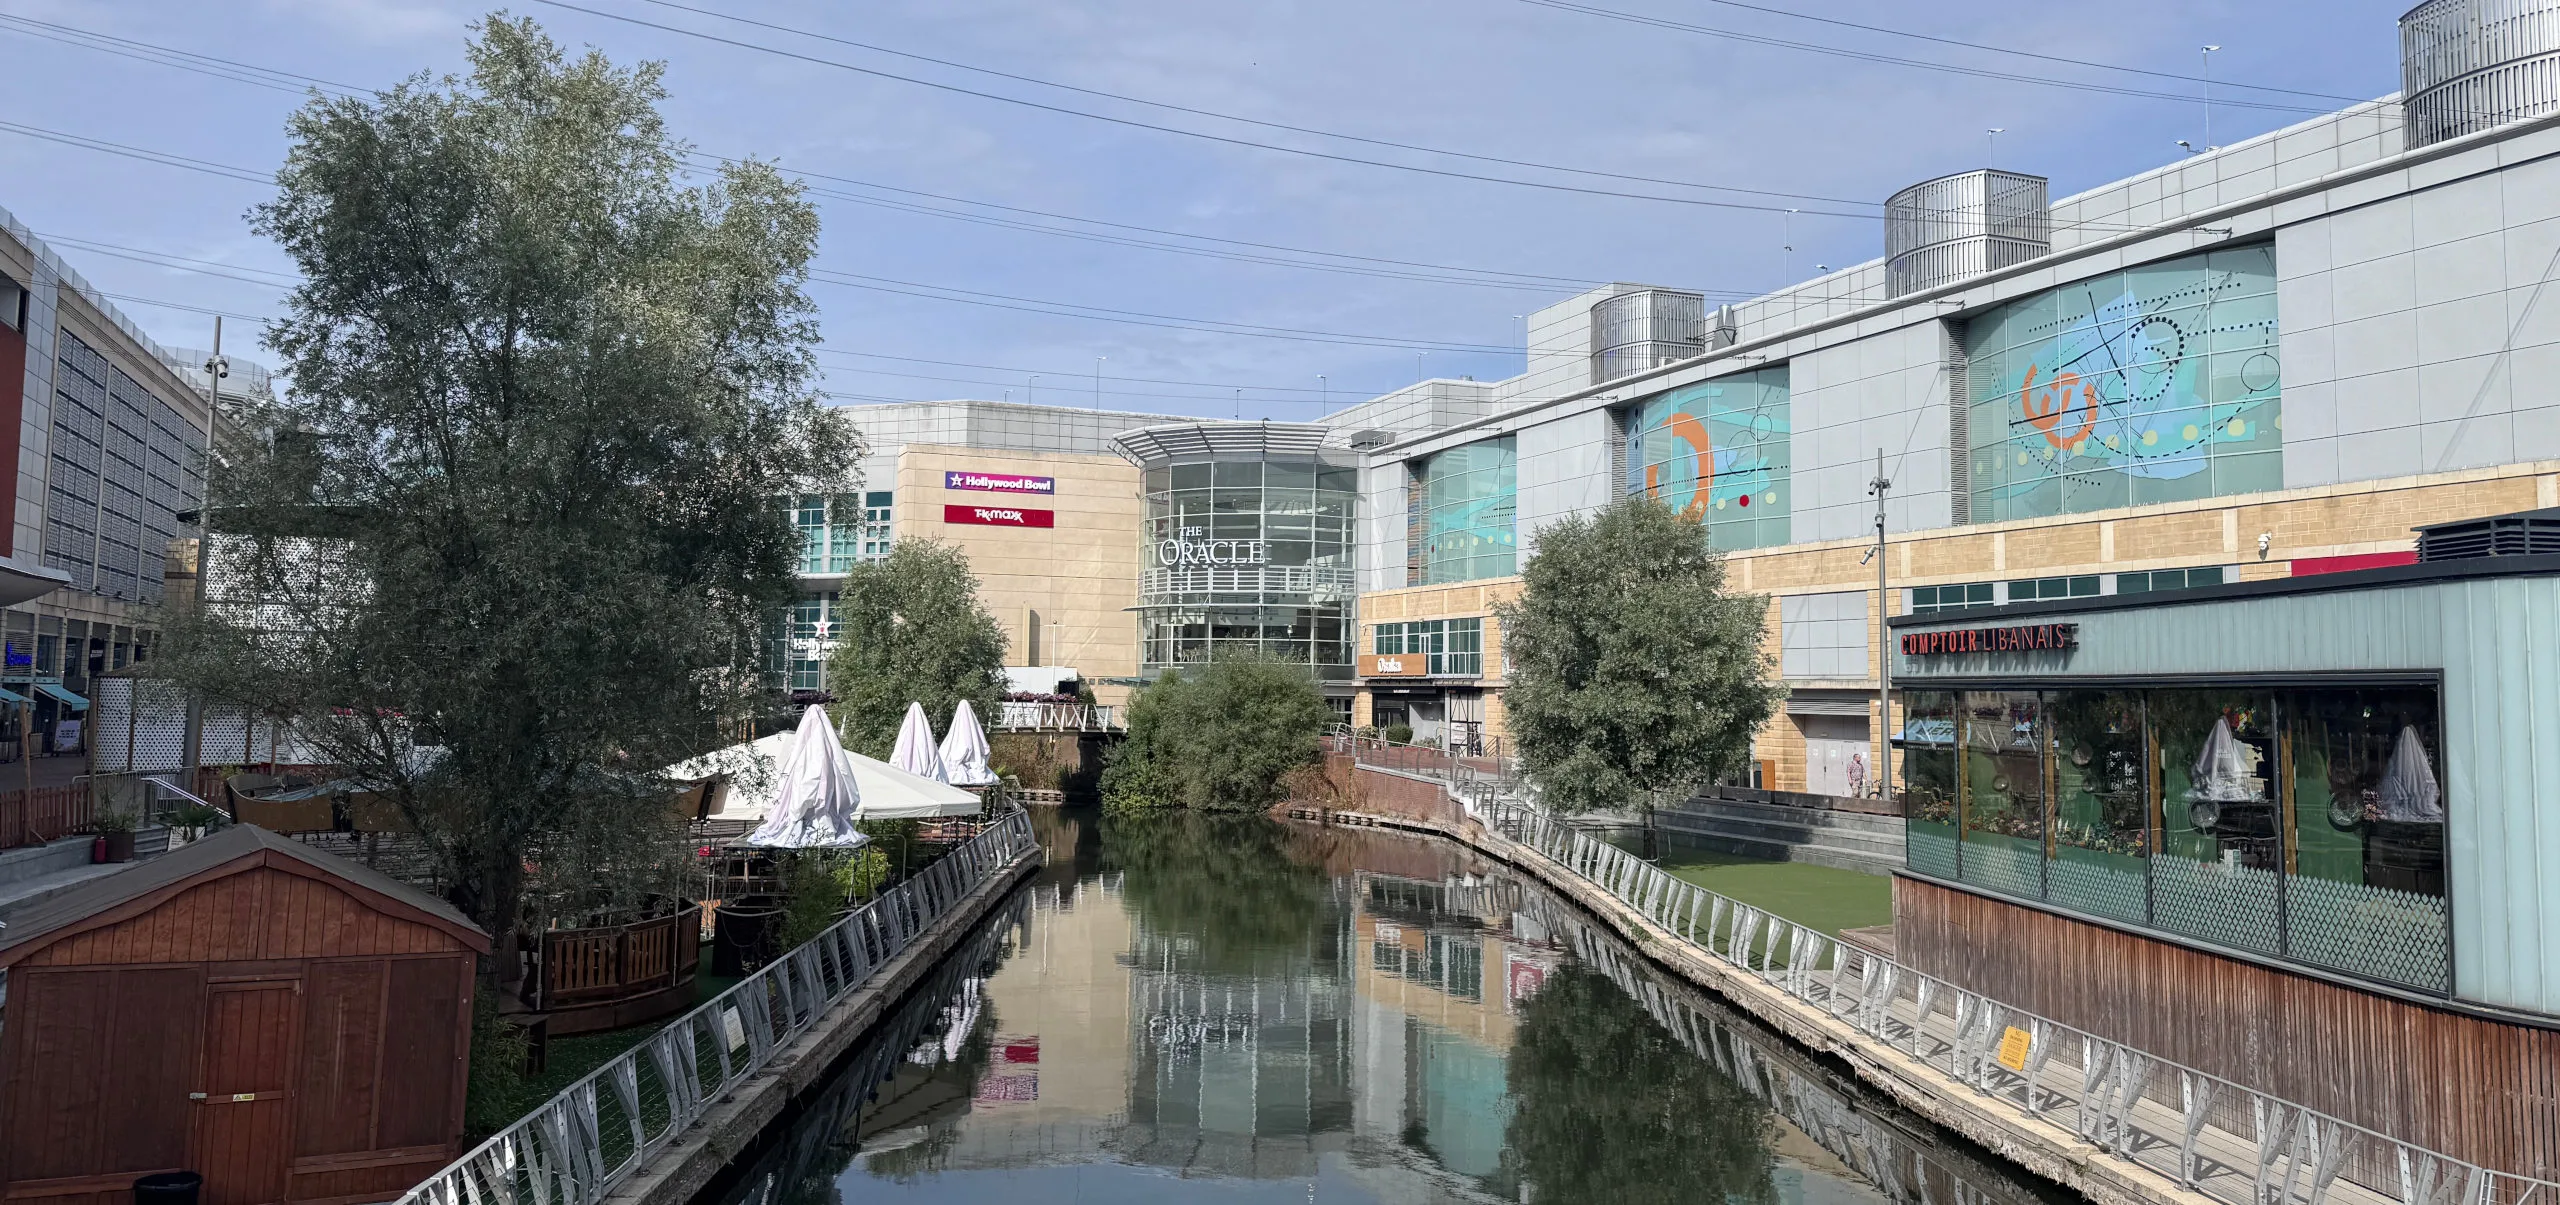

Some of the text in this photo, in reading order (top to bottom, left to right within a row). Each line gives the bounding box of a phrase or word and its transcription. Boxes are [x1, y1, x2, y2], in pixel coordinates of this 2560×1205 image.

[966, 475, 1051, 491] Hollywood Bowl
[1180, 526, 1202, 537] THE
[1159, 538, 1266, 566] ORACLE
[1901, 623, 2065, 656] COMPTOIR LIBANAIS
